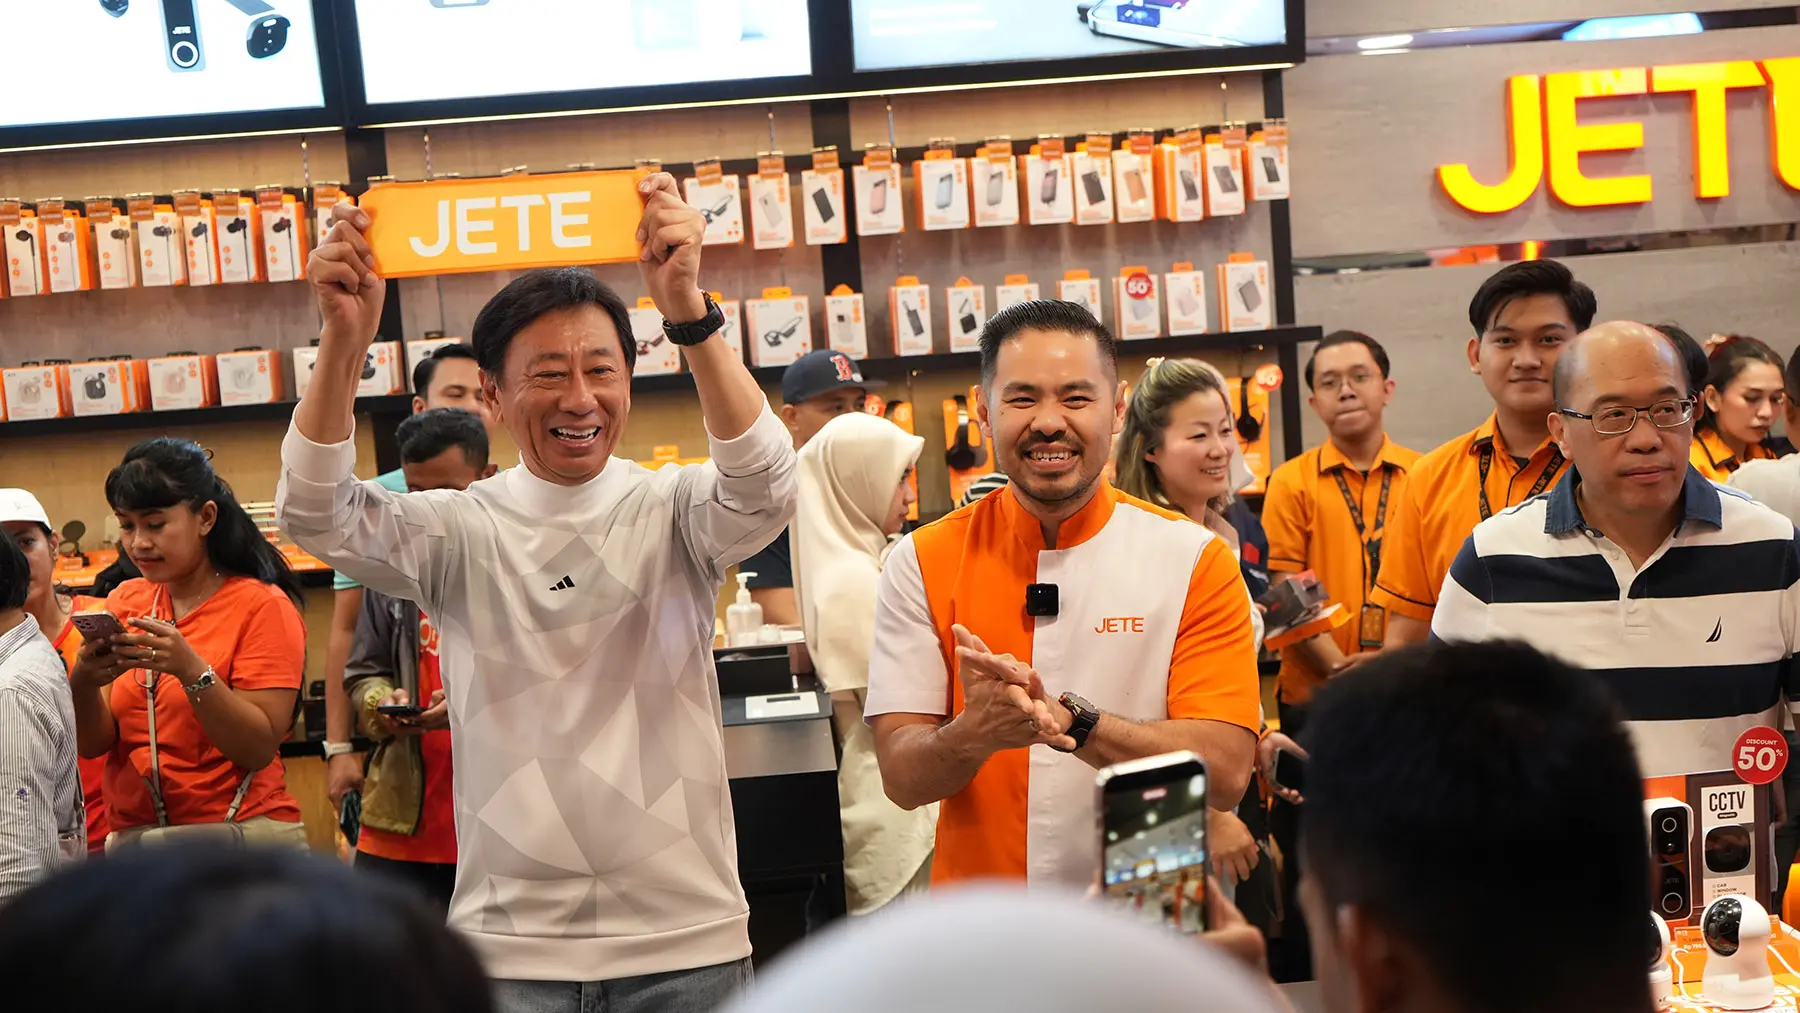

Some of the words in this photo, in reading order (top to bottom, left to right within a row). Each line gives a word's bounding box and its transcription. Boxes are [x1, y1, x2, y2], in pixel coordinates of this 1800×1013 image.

[408, 190, 592, 258] JETE
[1094, 616, 1144, 634] JETE
[1746, 738, 1778, 746] DISCOUNT
[1709, 790, 1746, 812] CCTV
